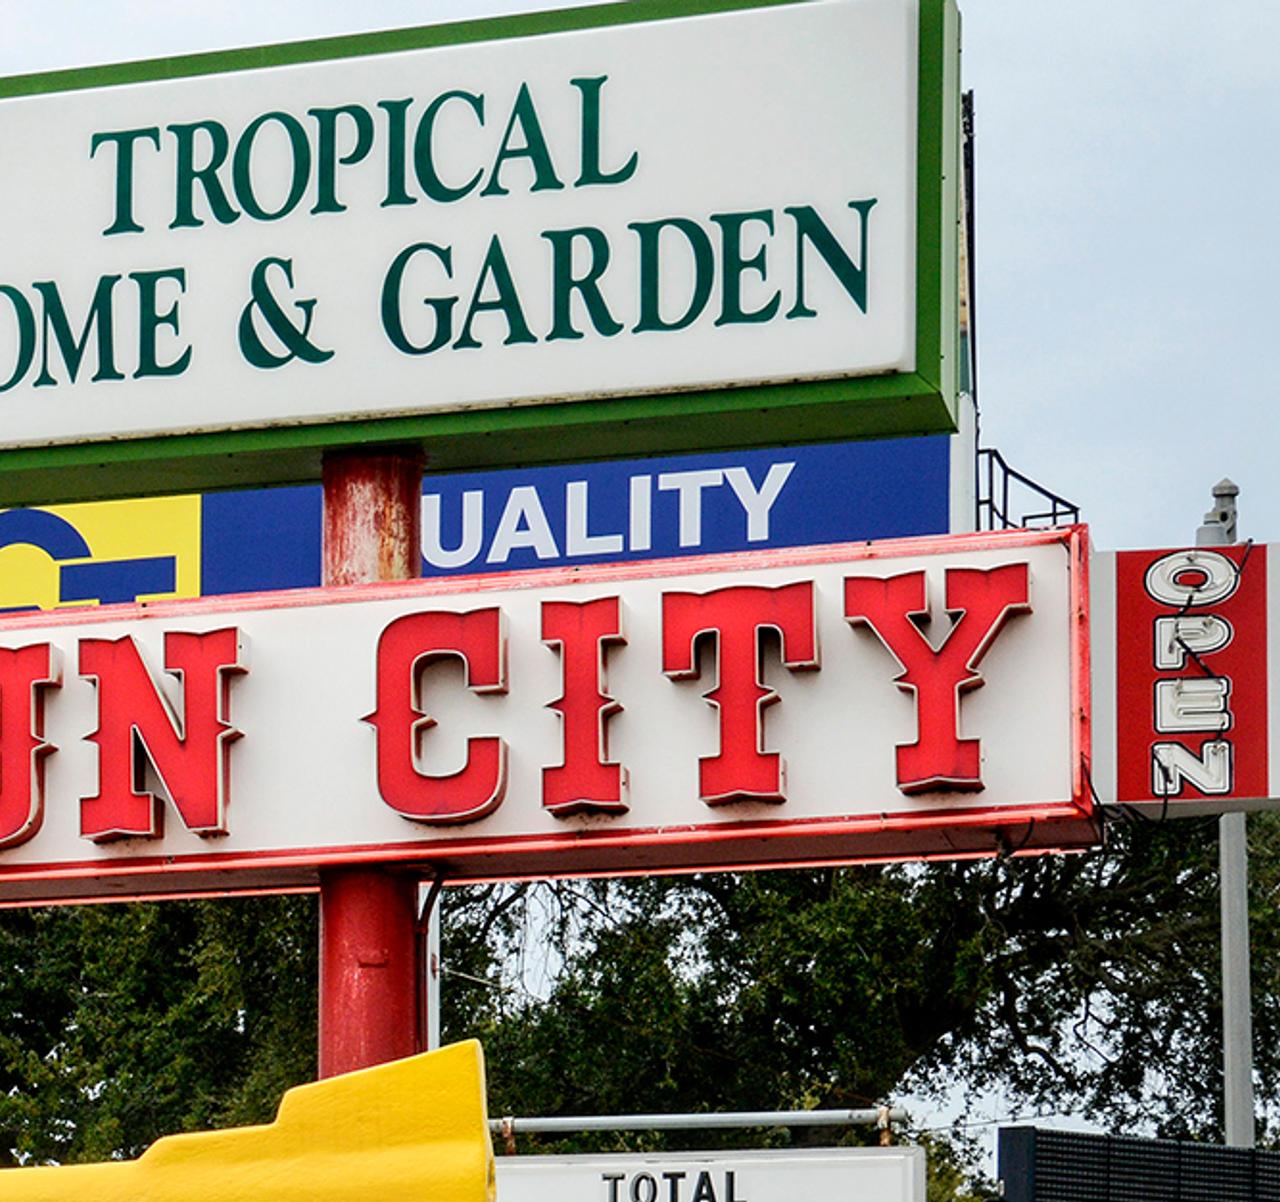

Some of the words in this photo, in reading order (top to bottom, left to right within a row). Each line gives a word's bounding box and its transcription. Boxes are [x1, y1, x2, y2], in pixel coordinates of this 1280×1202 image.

[91, 75, 638, 236] TROPICAL
[239, 257, 335, 370] &
[380, 199, 877, 356] GARDEN
[421, 461, 796, 570] UALITY
[360, 562, 1033, 825] CITY
[1143, 550, 1241, 796] OPEN
